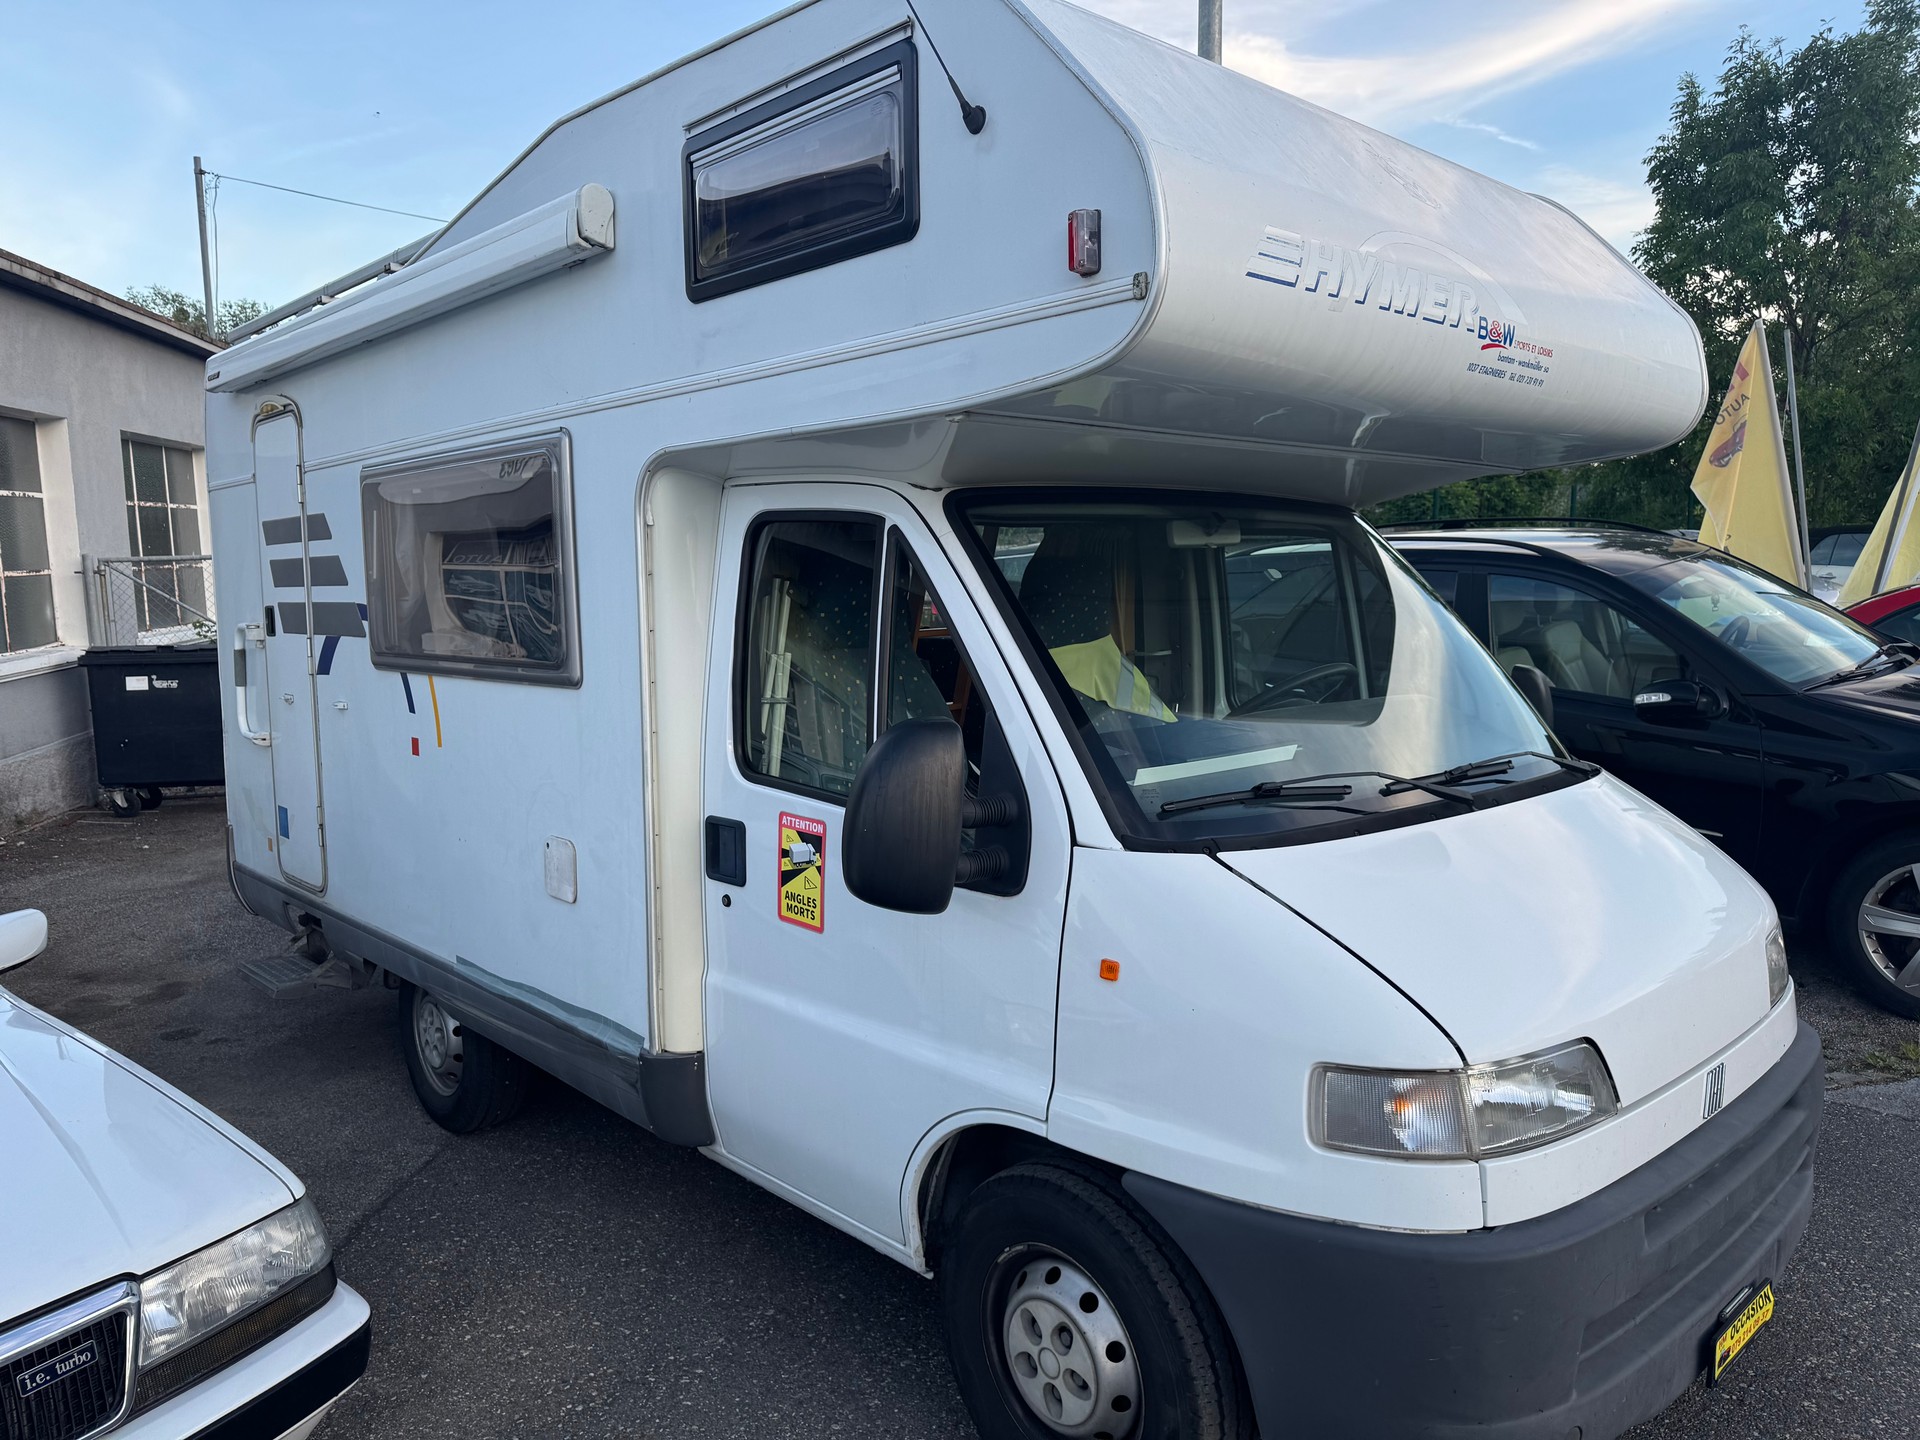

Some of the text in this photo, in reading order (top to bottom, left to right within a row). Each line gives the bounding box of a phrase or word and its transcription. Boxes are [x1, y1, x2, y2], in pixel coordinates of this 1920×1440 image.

[1304, 239, 1479, 332] HYMER
[1478, 316, 1515, 347] B&W
[1514, 339, 1531, 352] SPORTS
[1537, 345, 1553, 358] LOISIRS
[782, 815, 823, 834] ATTENTION
[784, 890, 817, 909] ANGLES
[786, 902, 815, 921] MORTS
[1730, 1287, 1772, 1340] OCCASION
[24, 1349, 91, 1391] i.e. turbo
